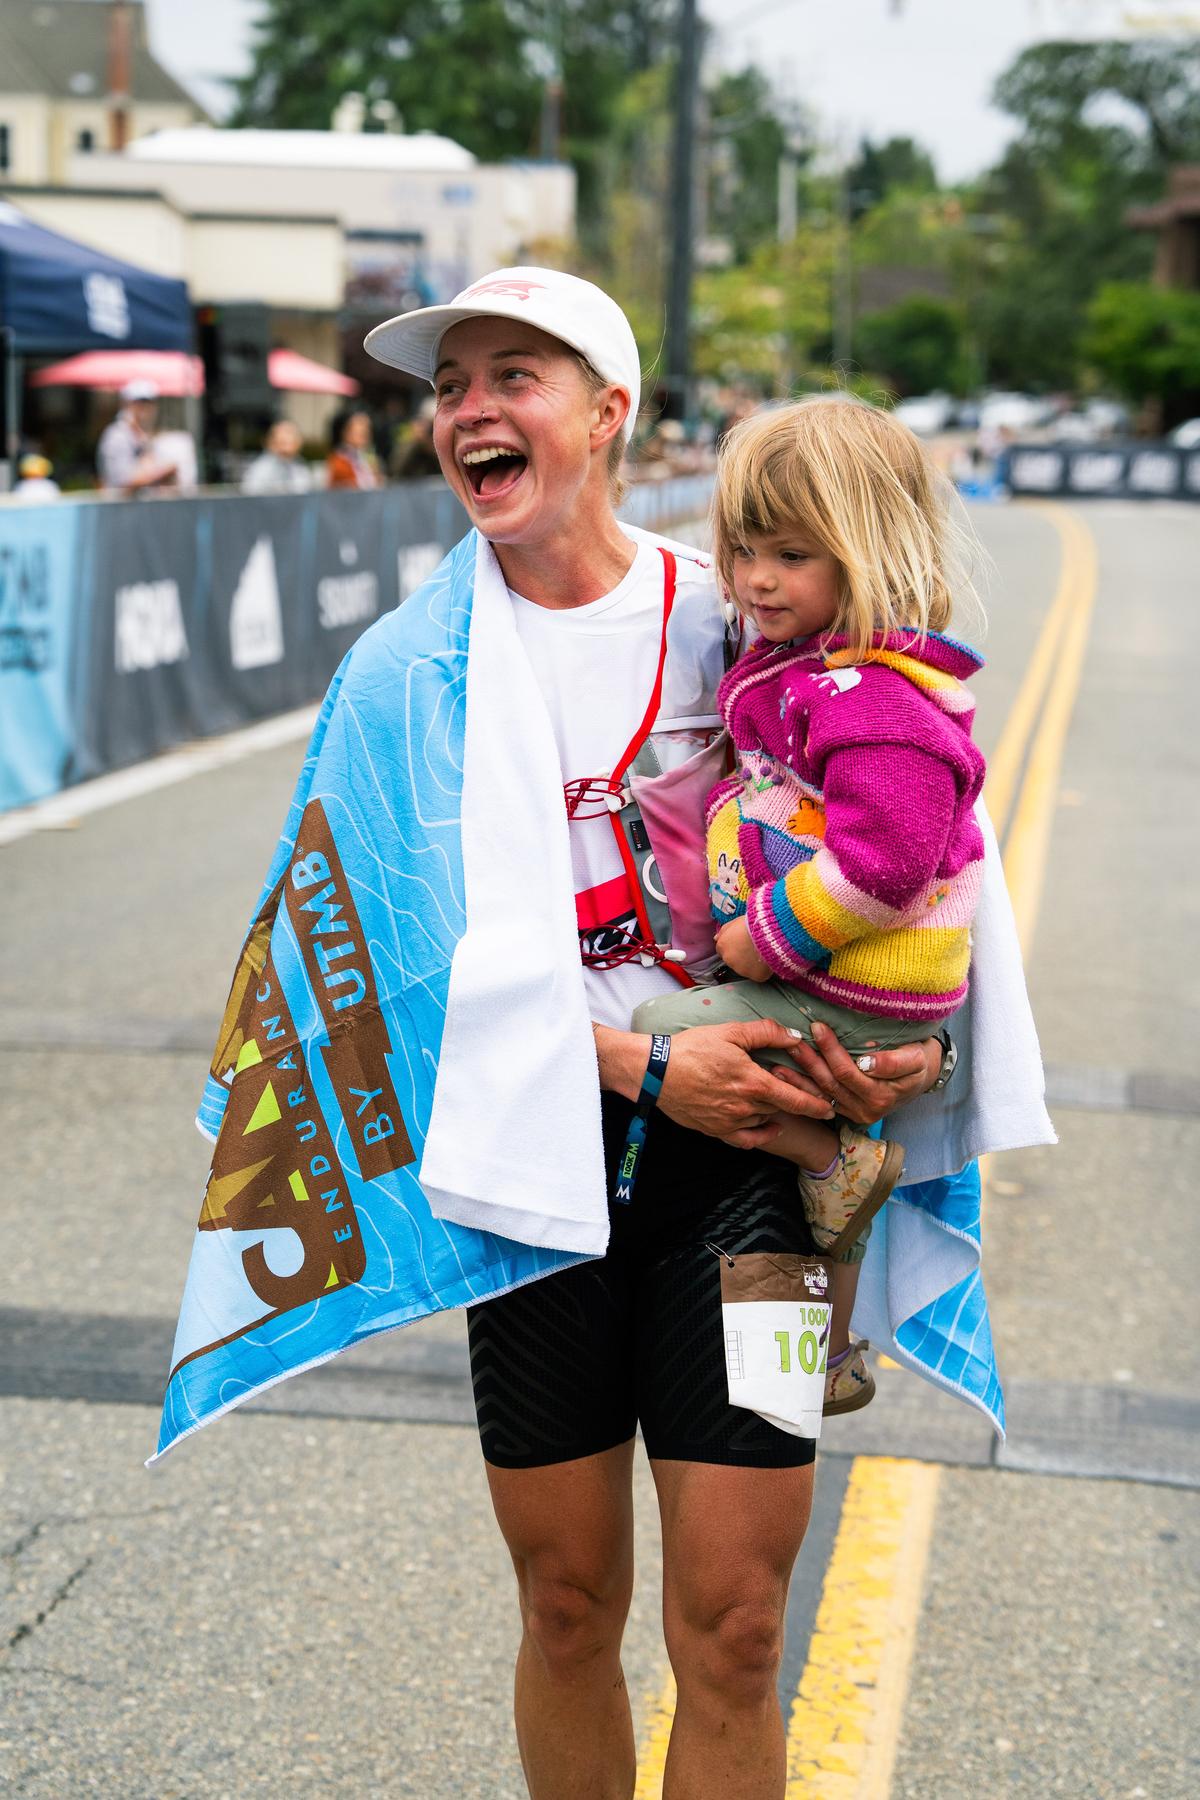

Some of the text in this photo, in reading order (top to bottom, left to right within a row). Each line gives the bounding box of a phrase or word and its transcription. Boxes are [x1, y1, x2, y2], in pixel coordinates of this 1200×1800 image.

[256, 980, 353, 1243] ENDURANC
[348, 1087, 395, 1146] BY
[799, 1307, 829, 1326] 100K
